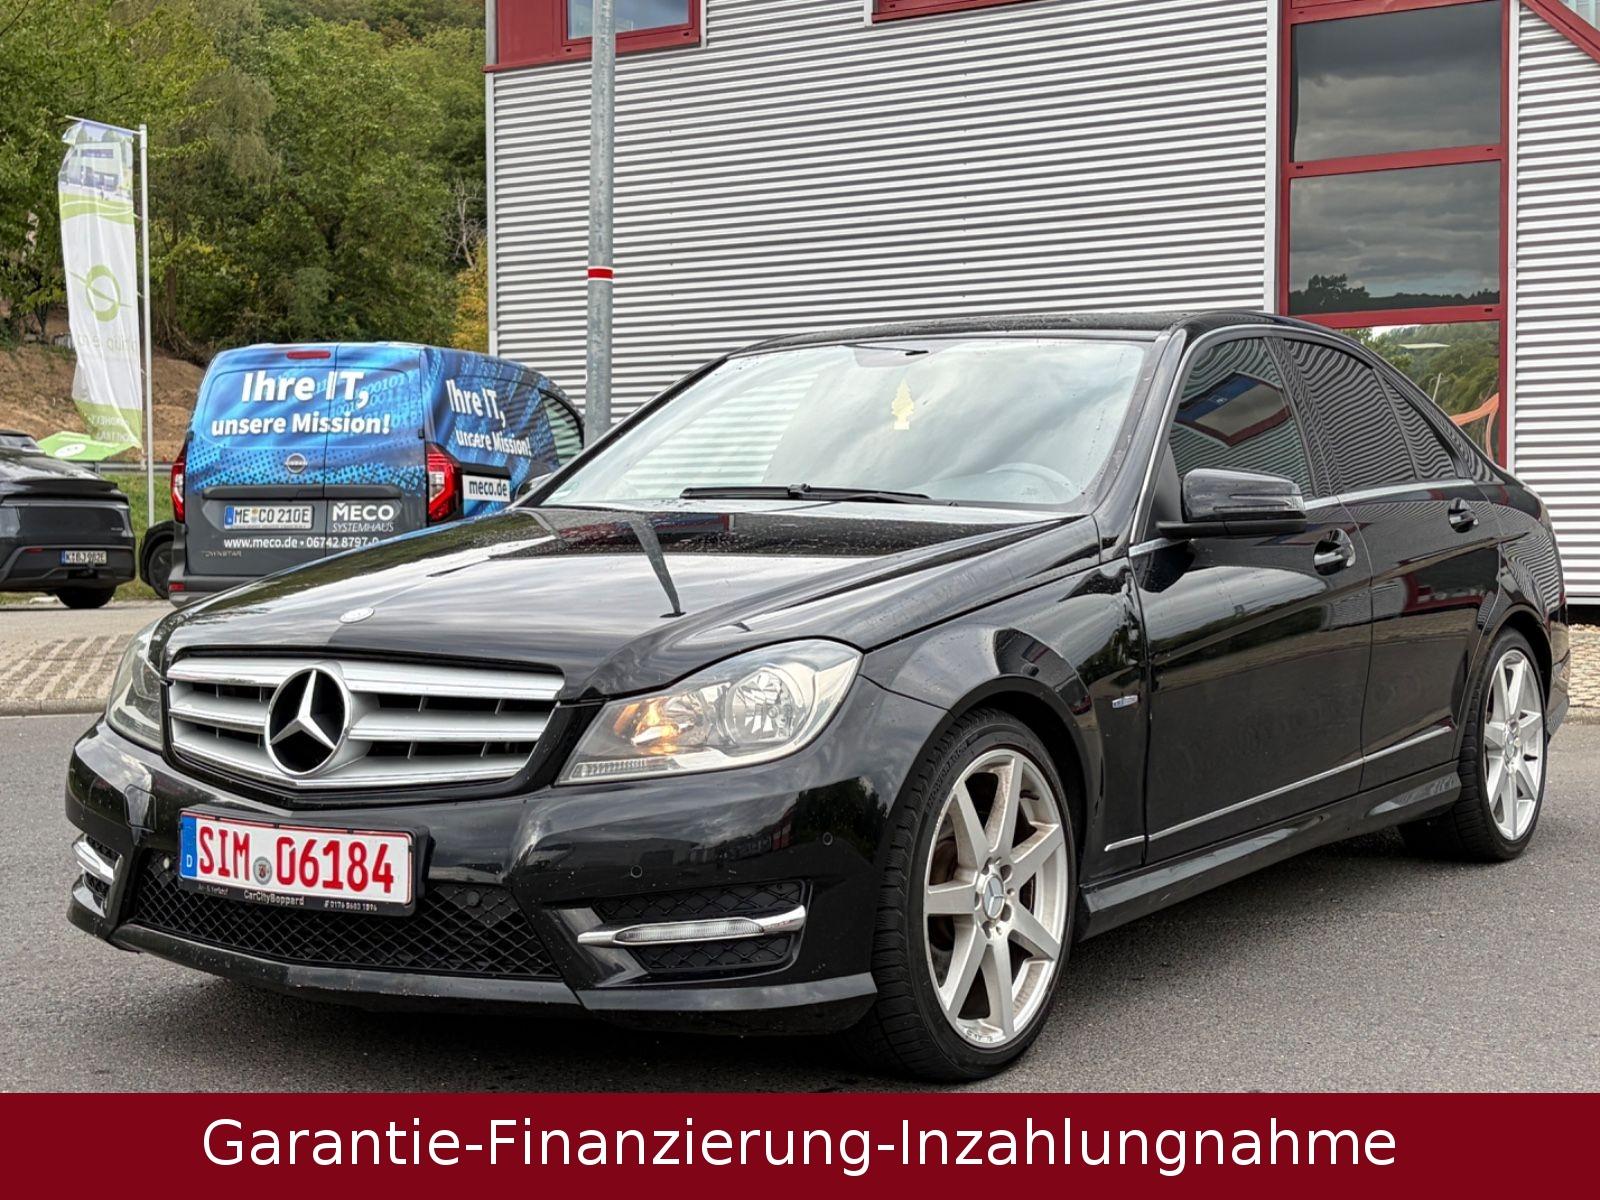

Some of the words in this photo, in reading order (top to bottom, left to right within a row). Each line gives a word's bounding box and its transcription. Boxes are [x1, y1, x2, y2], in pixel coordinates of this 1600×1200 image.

[241, 369, 316, 403] Ihre
[325, 370, 370, 409] IT,
[446, 378, 484, 417] Ihre
[482, 387, 506, 428] IT,
[211, 415, 286, 437] unsere
[291, 410, 391, 436] Mission!
[492, 430, 533, 457] Mission!
[468, 479, 508, 497] meco.de
[234, 508, 250, 522] ME
[258, 508, 275, 522] CO
[277, 508, 310, 522] 210E
[332, 502, 394, 521] MECO
[332, 521, 394, 533] SYSTEMHAUS
[223, 536, 298, 549] www.meco.de
[306, 536, 339, 549] 06742
[186, 854, 193, 868] D
[199, 825, 251, 881] SIM
[276, 836, 394, 894] 06184
